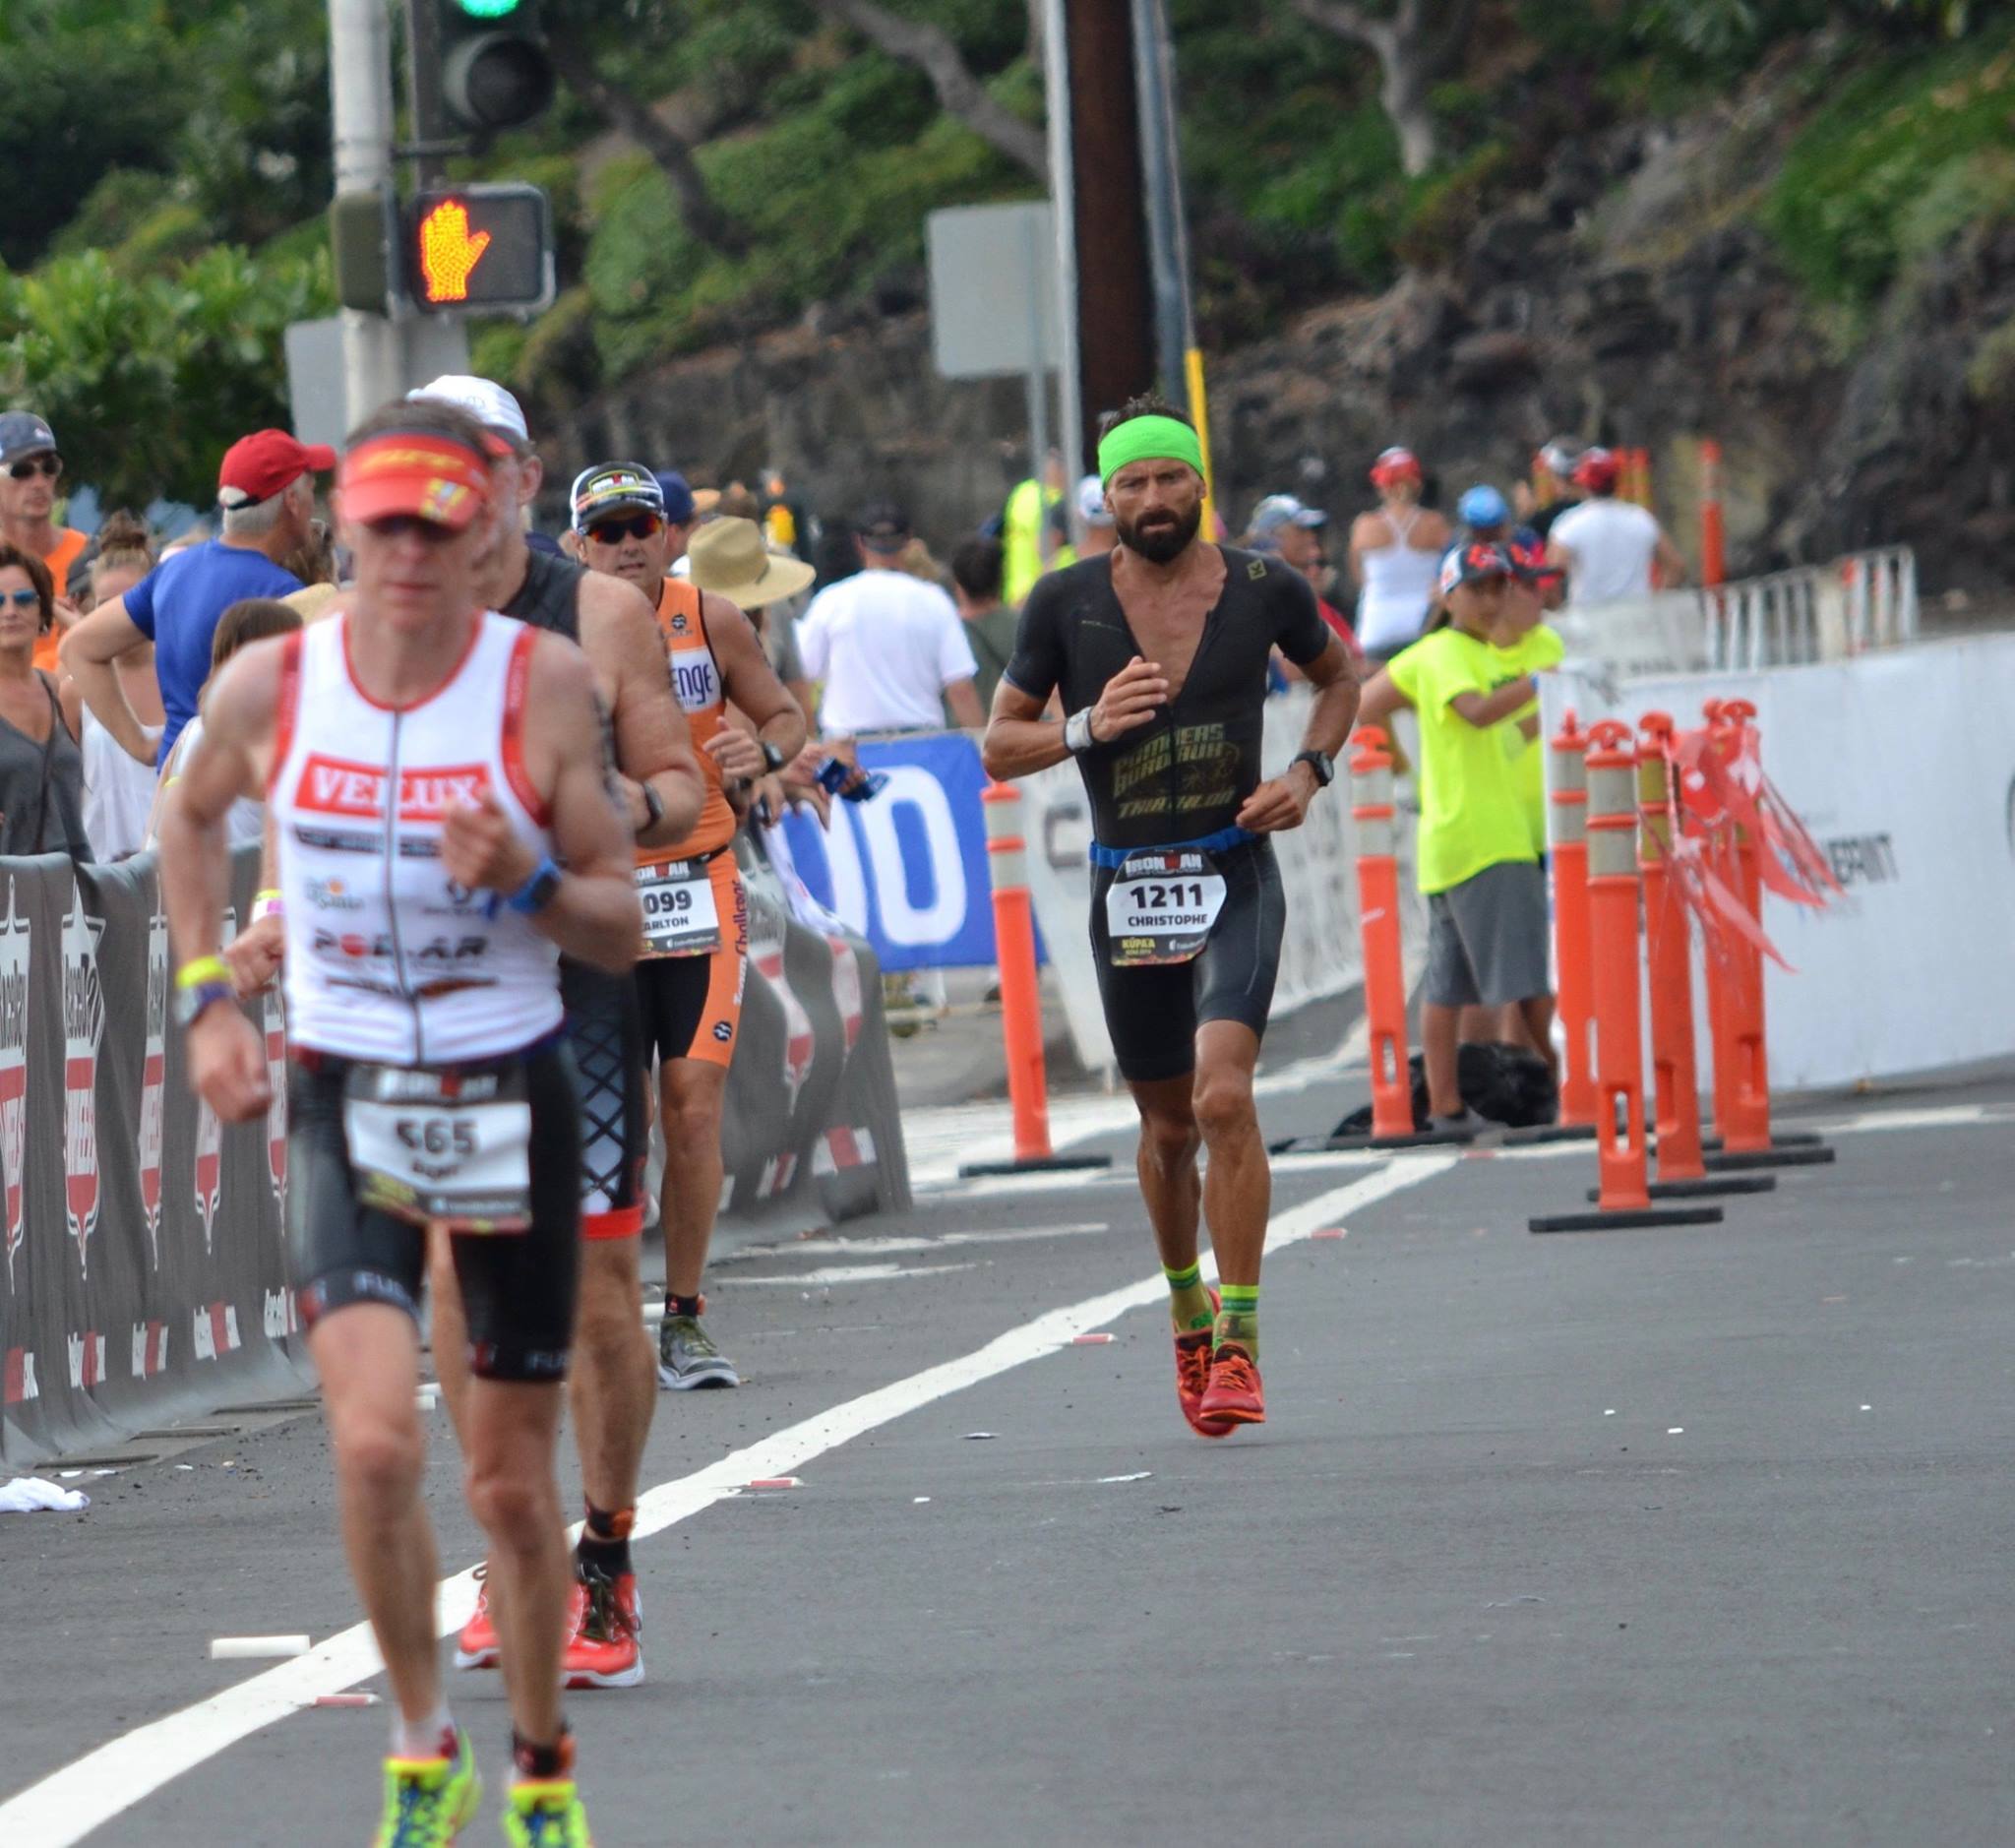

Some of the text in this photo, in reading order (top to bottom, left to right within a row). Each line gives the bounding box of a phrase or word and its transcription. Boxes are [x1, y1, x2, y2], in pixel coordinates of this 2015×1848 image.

[312, 765, 482, 812] VELUX
[1126, 851, 1202, 873] IRONMAN
[642, 889, 693, 914] 099
[1130, 884, 1203, 909] 1211
[644, 915, 690, 931] ARLTON
[1128, 913, 1208, 927] CHRISTOPHE
